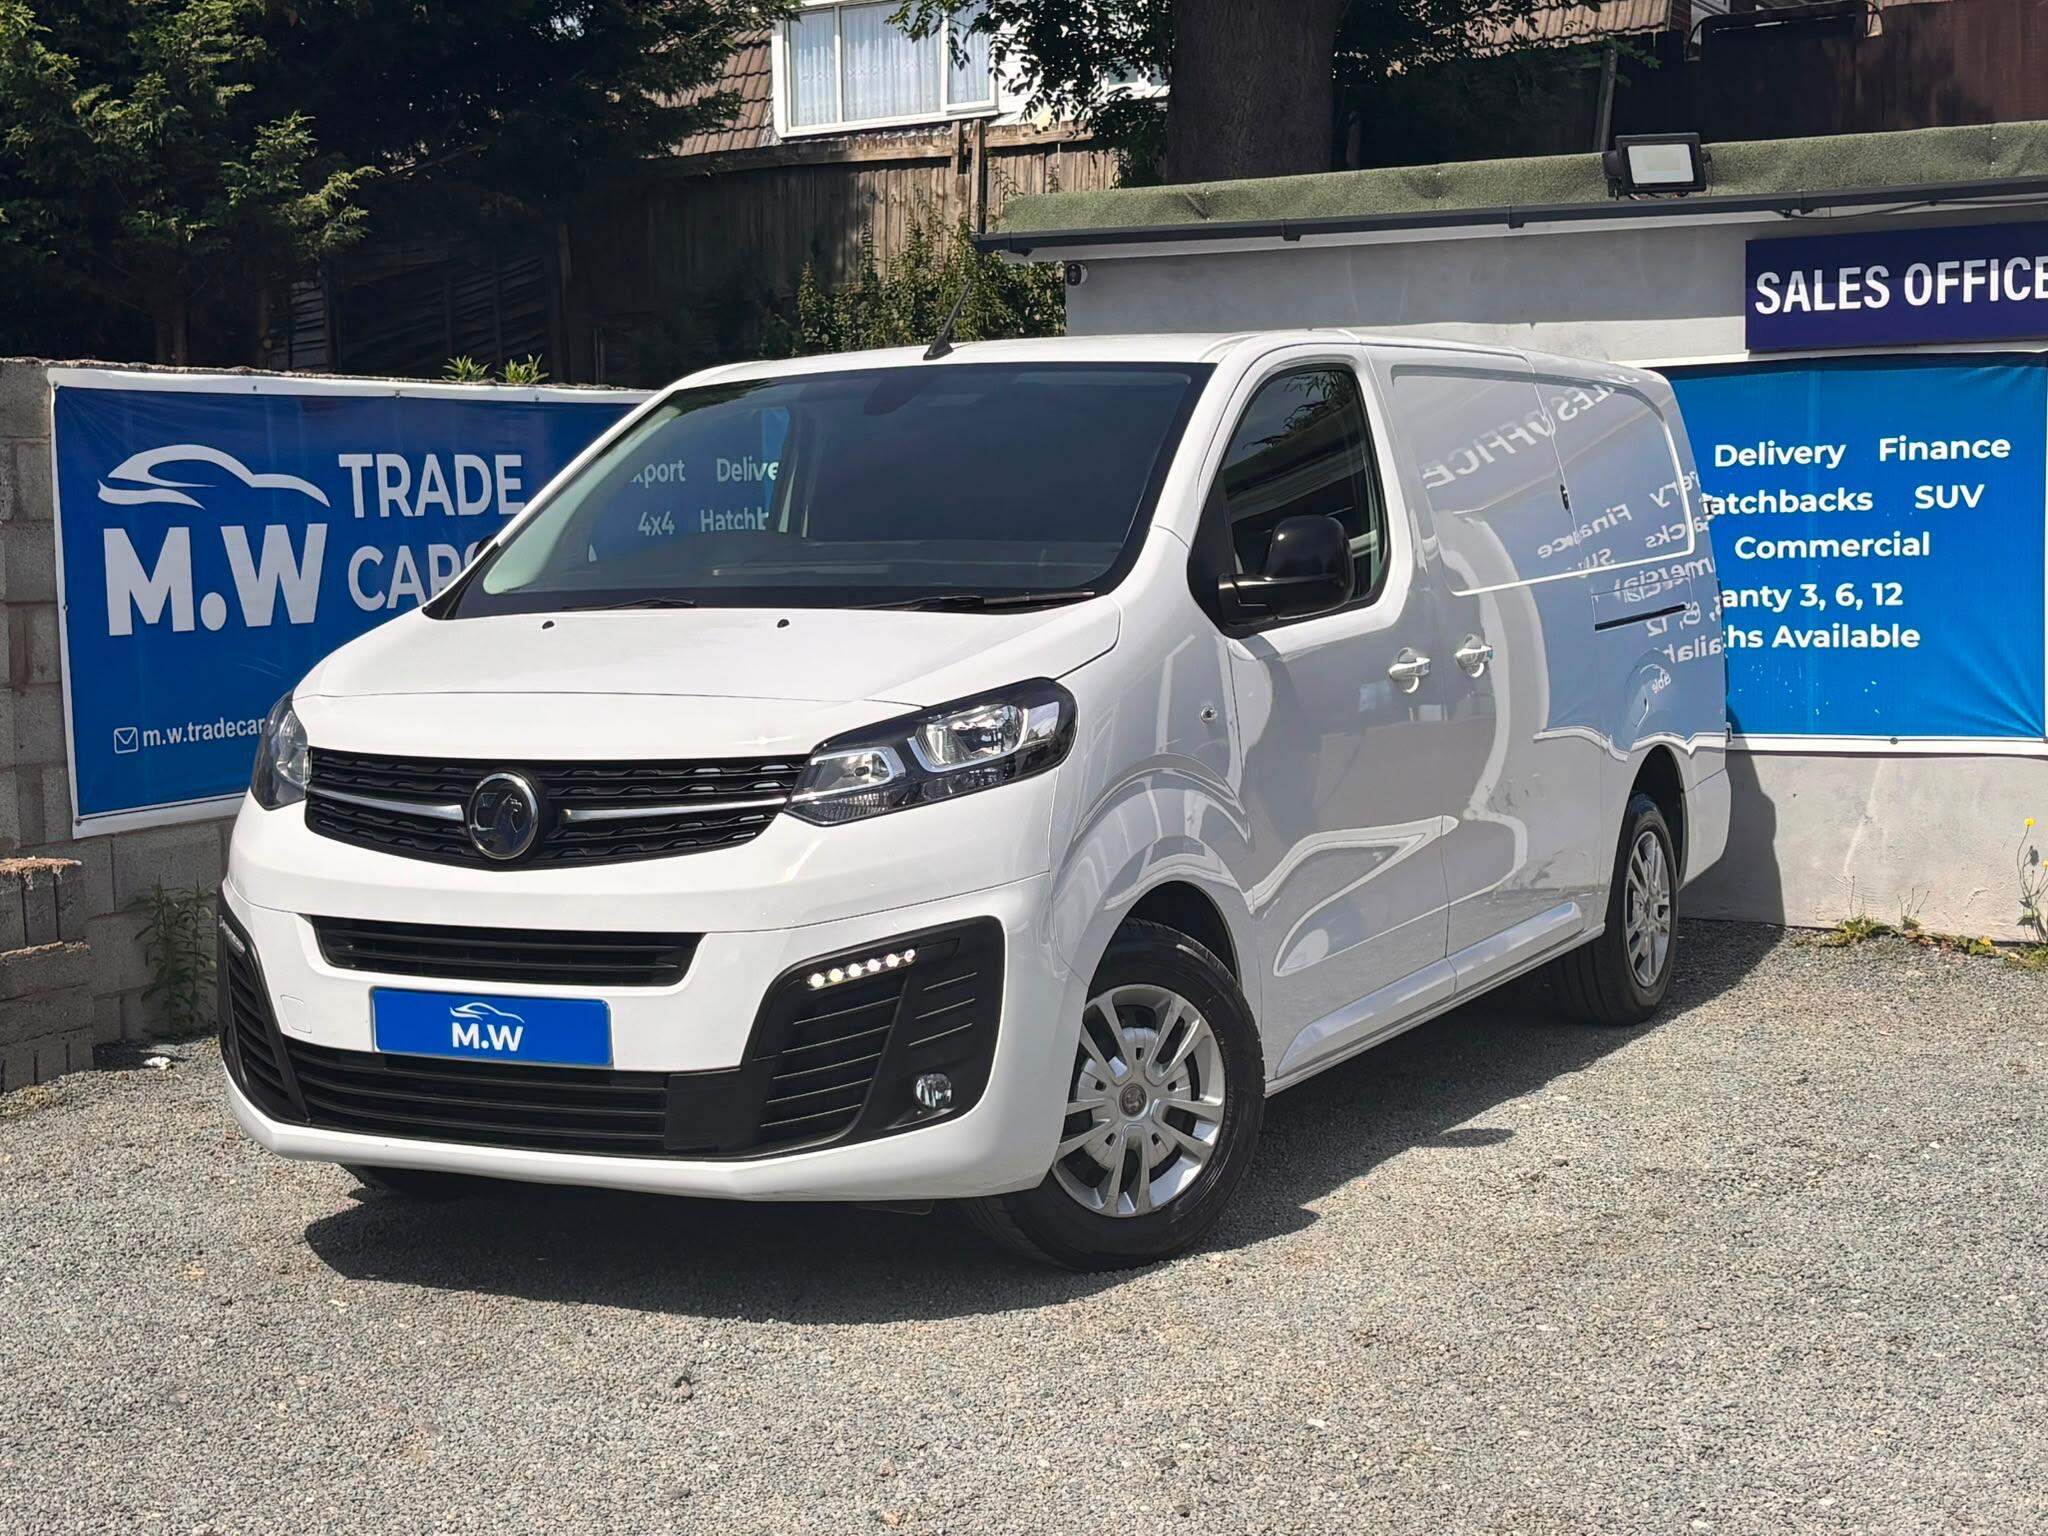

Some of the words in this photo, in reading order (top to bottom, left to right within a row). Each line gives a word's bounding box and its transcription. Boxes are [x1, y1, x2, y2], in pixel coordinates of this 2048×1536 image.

[1755, 265, 1890, 315] SALES
[1904, 256, 2048, 307] OFFICE
[1714, 440, 1847, 469] Delivery
[1879, 435, 2011, 462] Finance
[338, 453, 525, 518] TRADE
[1703, 487, 1874, 515] atchbacks
[1914, 484, 1985, 510] SUV
[638, 510, 675, 536] 4x4
[1734, 531, 1930, 560] Commercial
[103, 523, 328, 636] M.W
[348, 543, 480, 612] CAR
[1800, 584, 1826, 611] 3,
[1835, 583, 1863, 610] 6,
[1872, 582, 1904, 606] 12
[1772, 623, 1921, 649] Available
[452, 1022, 524, 1052] M.W
